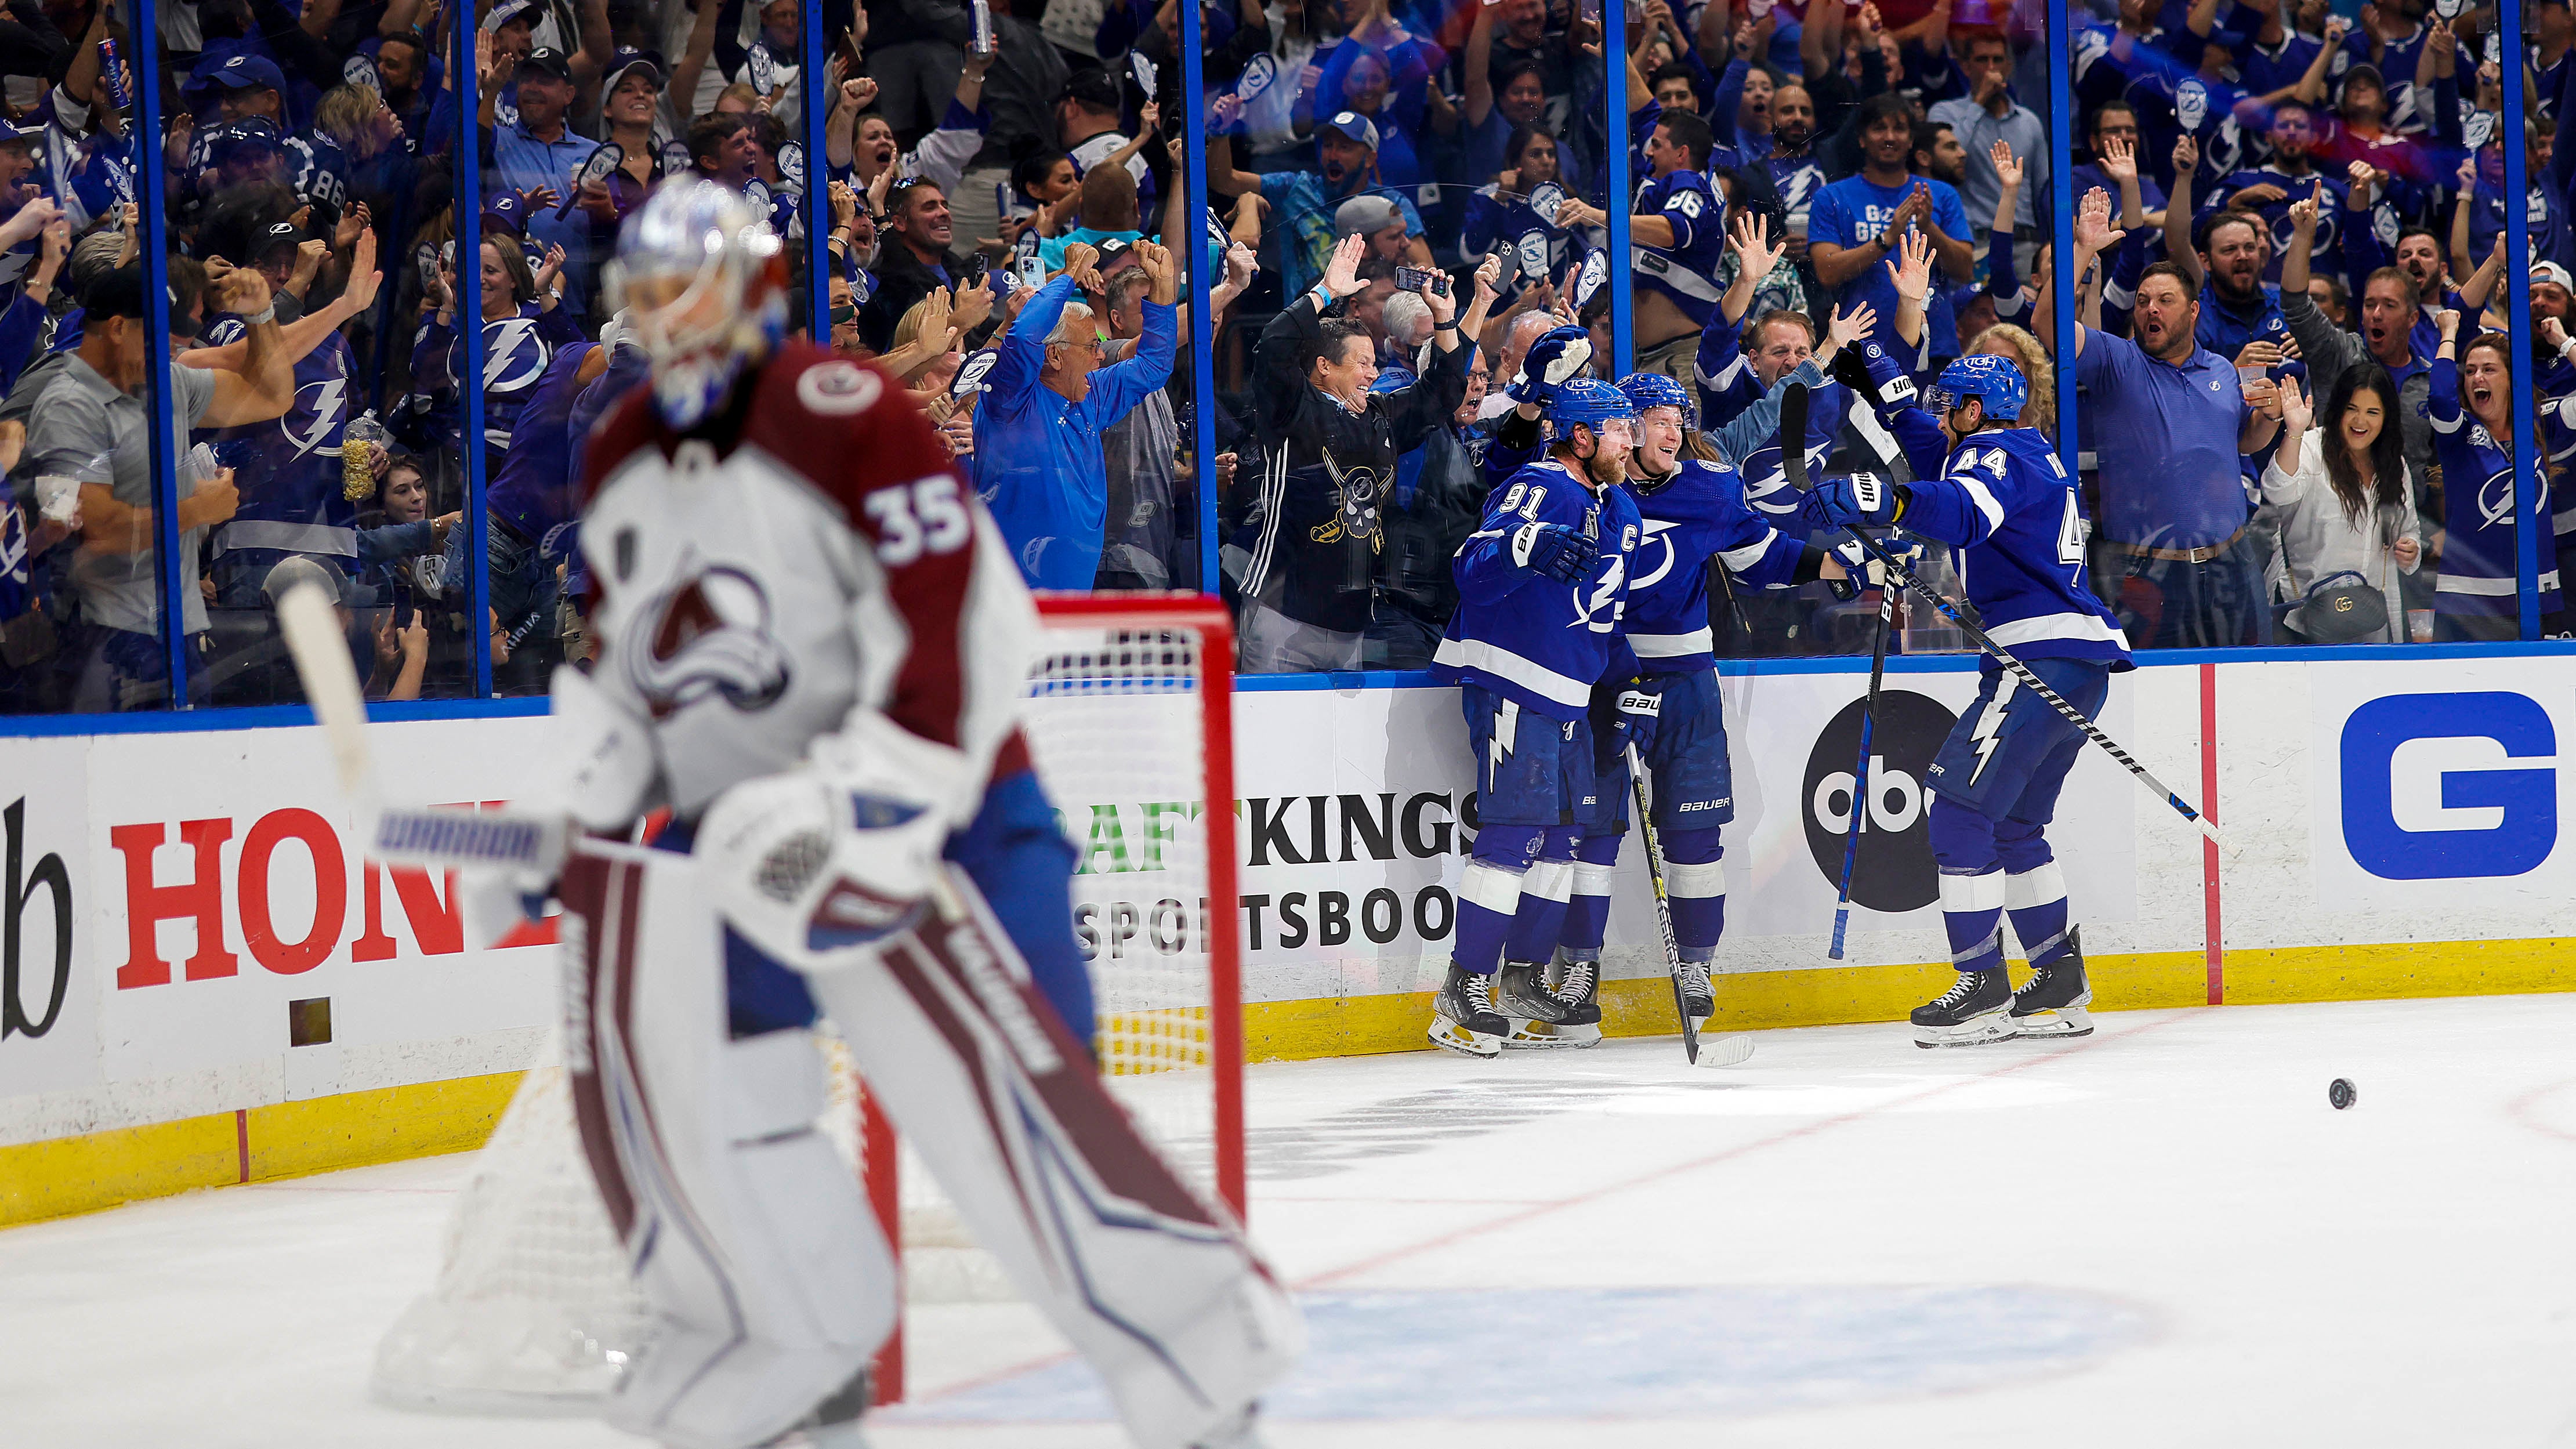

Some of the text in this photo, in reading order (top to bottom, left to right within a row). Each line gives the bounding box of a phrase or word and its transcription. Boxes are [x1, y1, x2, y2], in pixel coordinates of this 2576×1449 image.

[311, 170, 346, 209] 86
[1664, 189, 1704, 219] 86
[1570, 379, 1597, 388] TGH
[1951, 447, 2007, 481] 44
[1498, 482, 1548, 521] 91
[863, 473, 973, 567] 35
[1621, 524, 1638, 552] C
[1881, 524, 1903, 624] BAUR
[1621, 697, 1661, 711] BAU
[1679, 796, 1731, 813] BAUER
[1813, 754, 1936, 835] ab
[110, 799, 566, 991] HON
[1, 795, 73, 1042] b
[1074, 885, 1455, 962] SPOTSBOO
[1452, 999, 1462, 1019] BAUER
[1528, 999, 1556, 1017] BAUER
